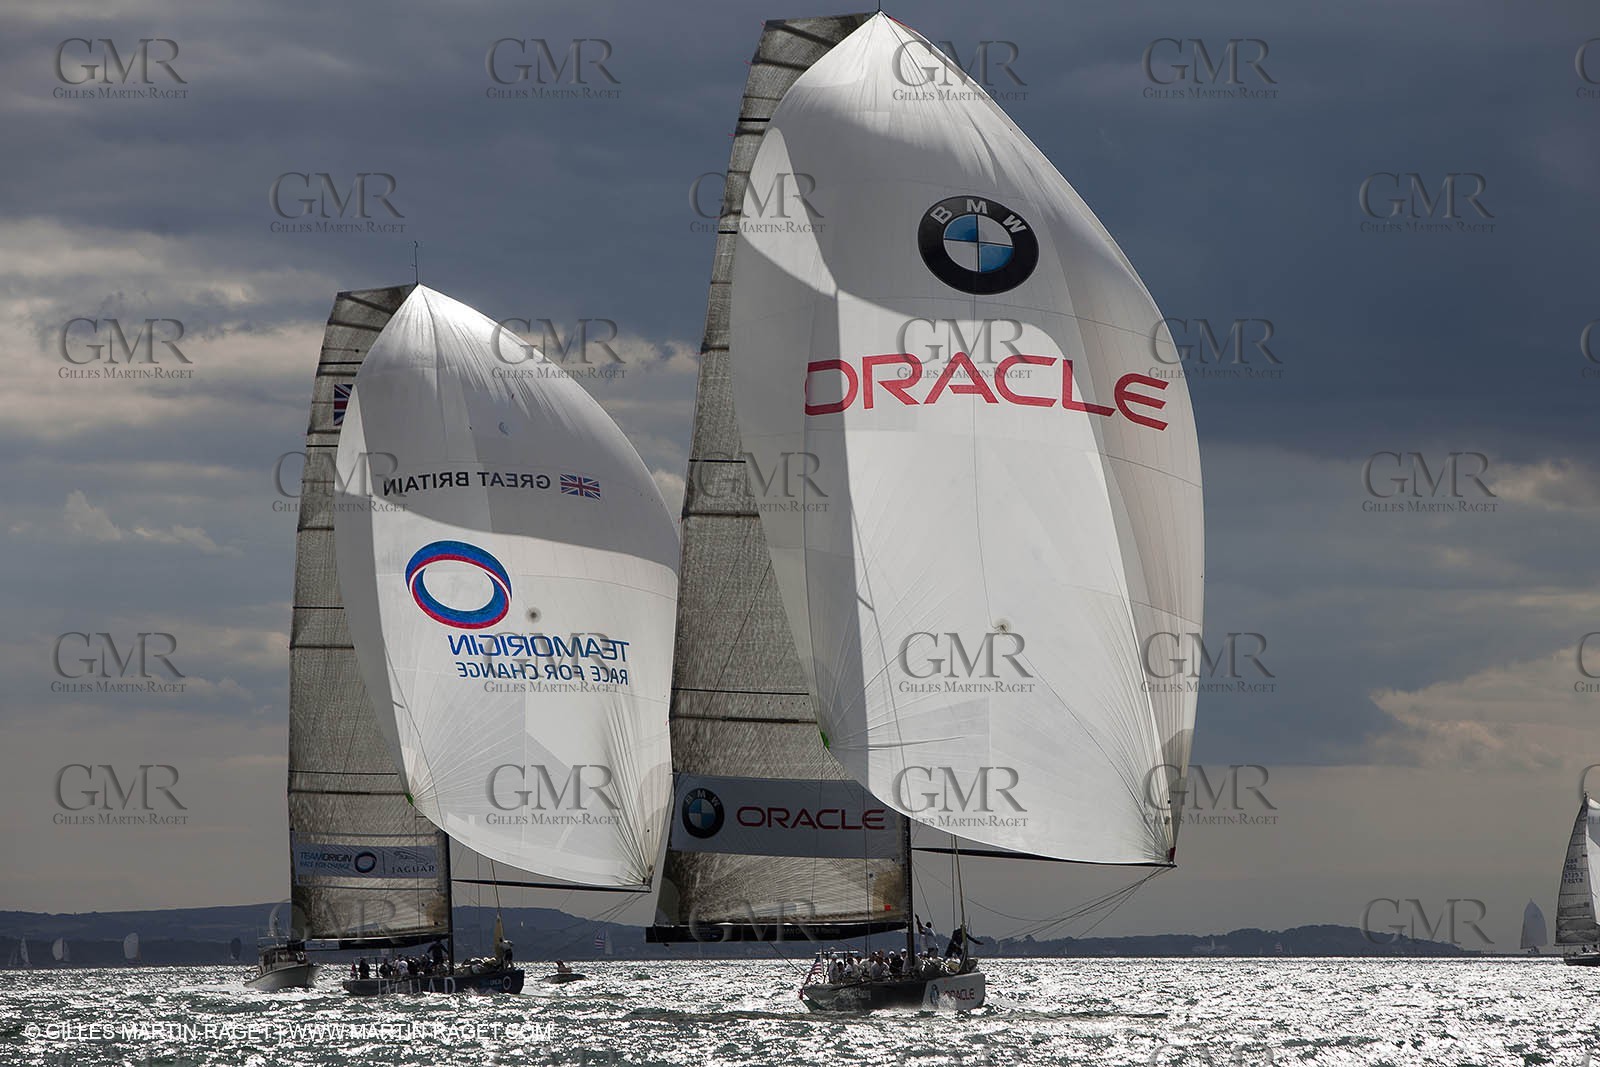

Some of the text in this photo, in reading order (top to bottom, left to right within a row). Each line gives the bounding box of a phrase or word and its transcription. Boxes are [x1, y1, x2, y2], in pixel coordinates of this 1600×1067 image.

[930, 199, 1027, 233] BMW
[804, 351, 1169, 431] ORACLE
[736, 806, 886, 830] ORACLE
[392, 865, 435, 874] JAGUAR
